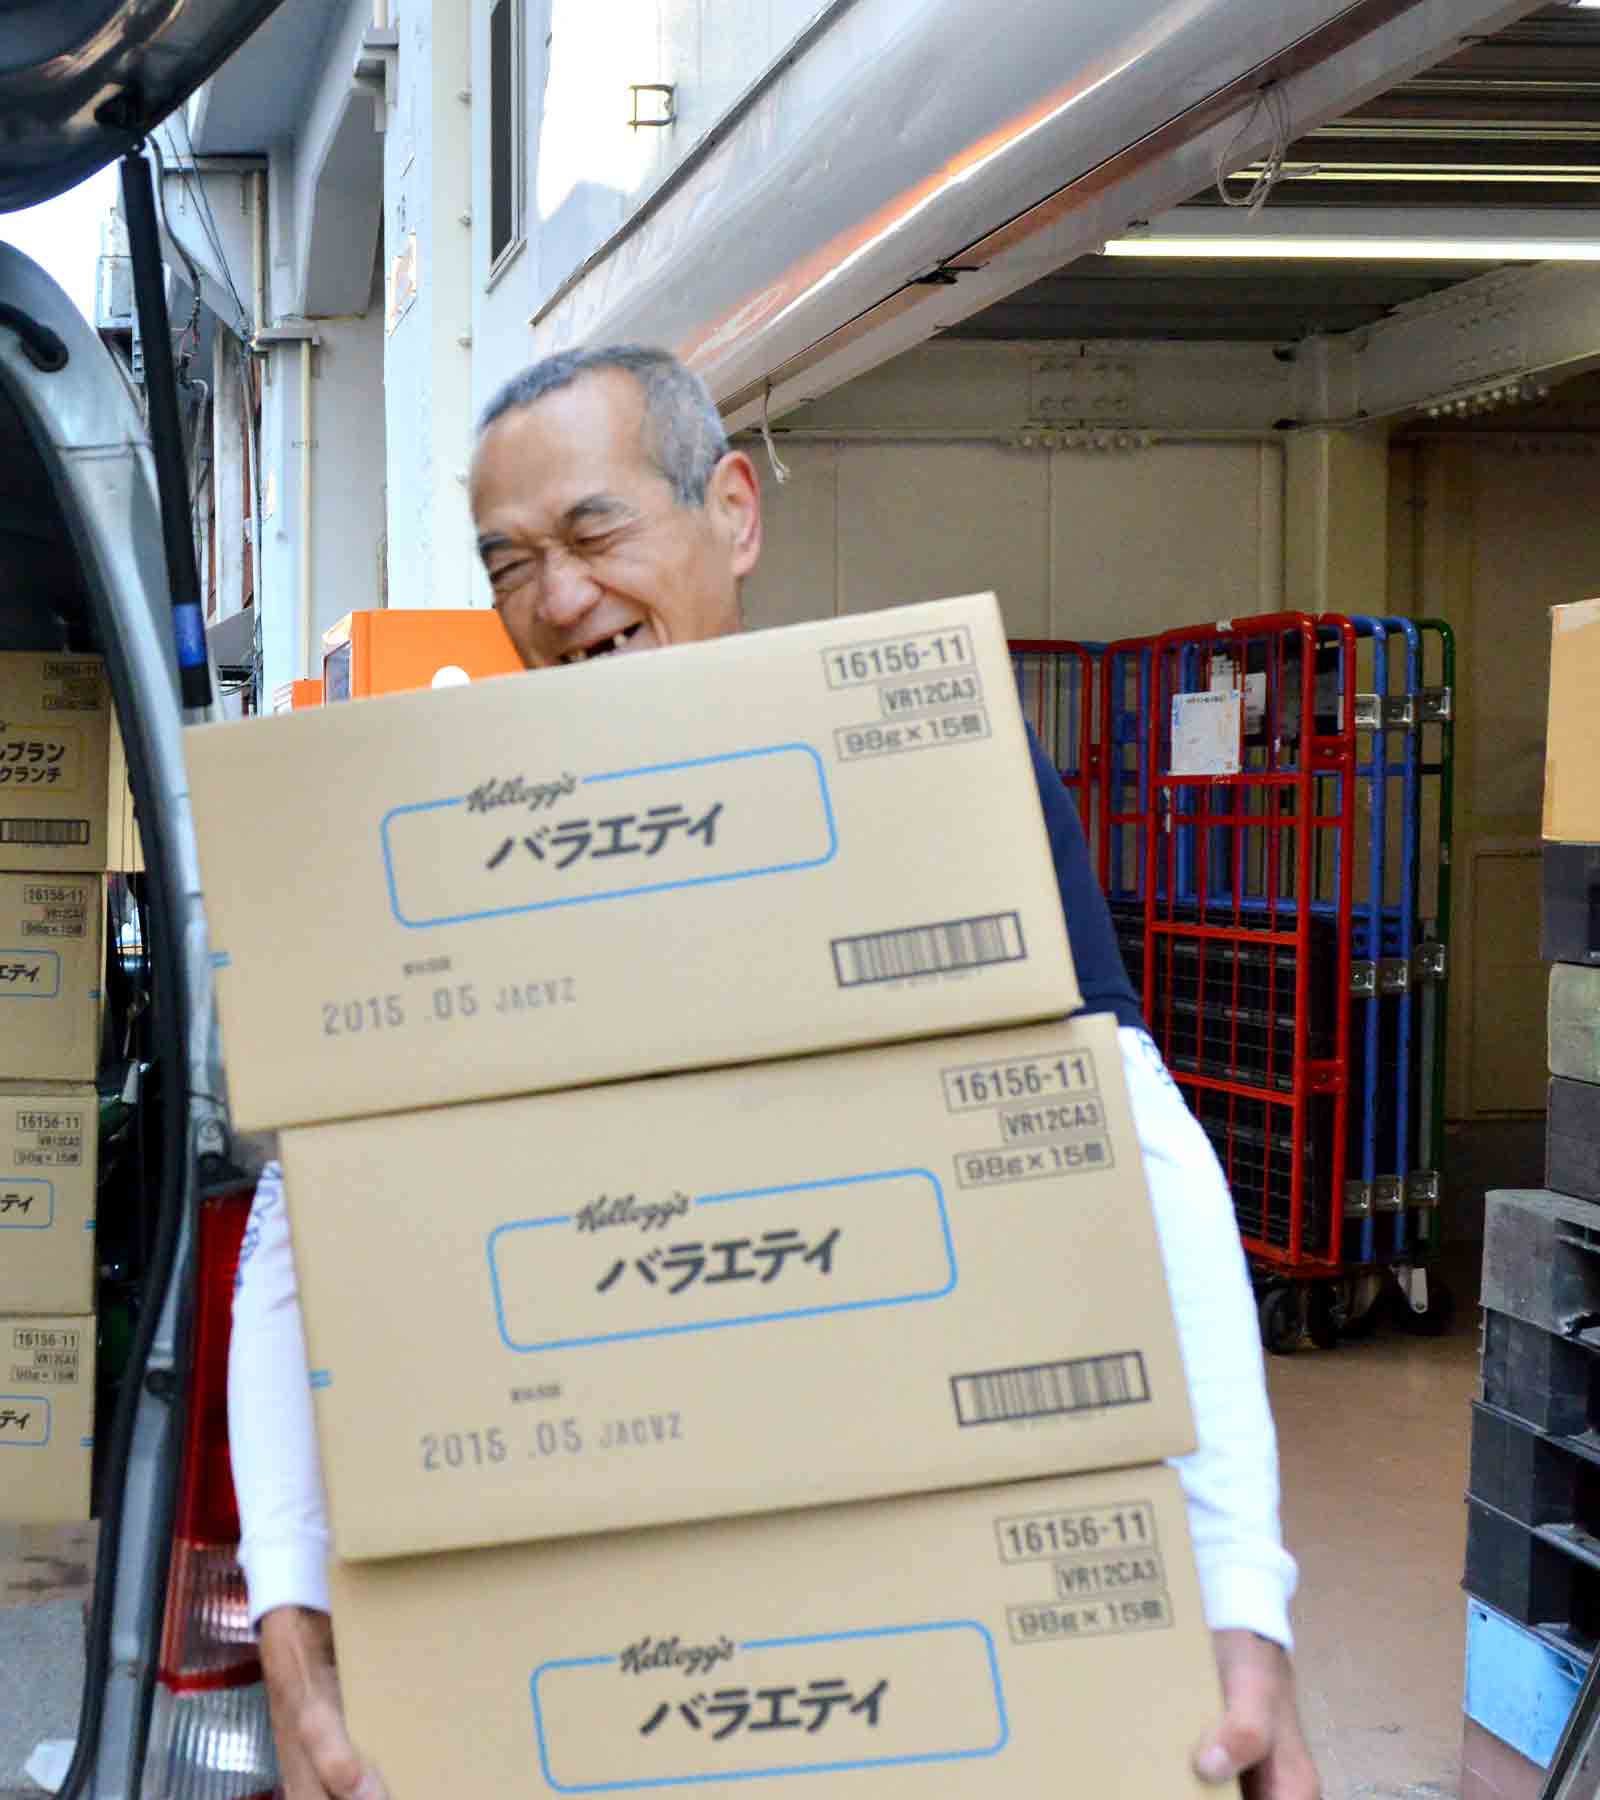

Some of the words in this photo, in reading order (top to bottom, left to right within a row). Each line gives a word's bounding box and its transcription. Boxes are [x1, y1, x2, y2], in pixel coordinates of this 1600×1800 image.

[834, 635, 965, 681] 16156-11
[885, 677, 977, 711] VR12CA3
[465, 772, 577, 815] Kellogg's
[486, 801, 725, 870] バラエティ
[322, 993, 404, 1036] 2015
[953, 1057, 1087, 1104] 16156-11
[1007, 1102, 1099, 1137] VR12CA3
[576, 1192, 689, 1234] Kellogg's
[596, 1228, 841, 1294] バラエティ
[419, 1425, 507, 1471] 2015
[1007, 1511, 1145, 1556] 16156-11
[1060, 1560, 1158, 1593] VR12CA3
[619, 1634, 734, 1677] Kellogg's
[639, 1678, 889, 1742] バラエティ
